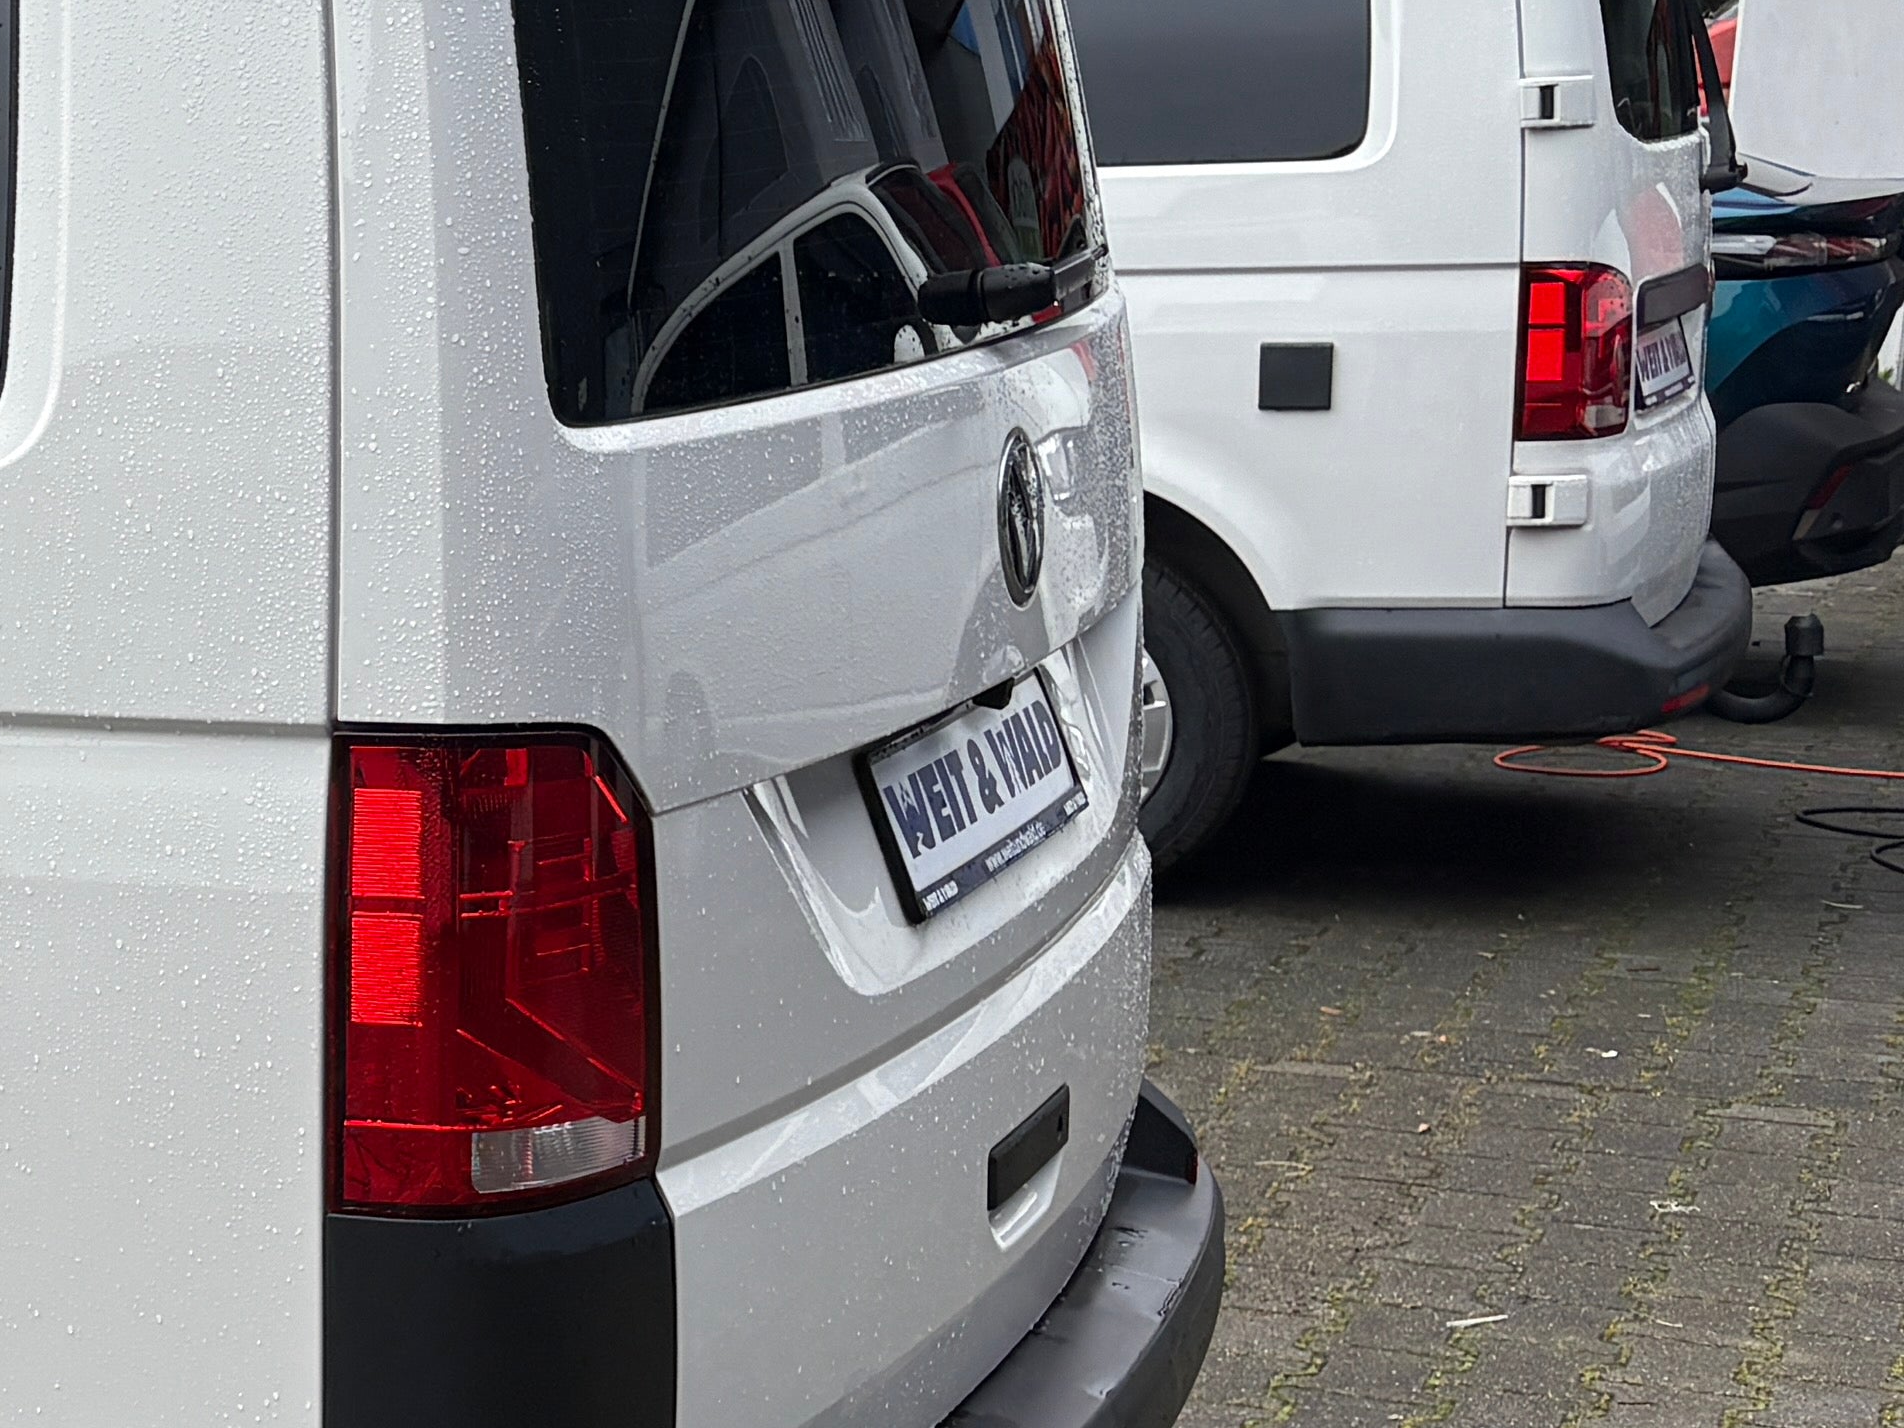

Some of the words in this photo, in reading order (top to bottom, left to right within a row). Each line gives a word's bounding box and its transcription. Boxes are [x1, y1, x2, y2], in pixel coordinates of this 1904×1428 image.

[967, 738, 1005, 814] &
[983, 700, 1061, 799] WALD
[882, 749, 978, 859] WEIT
